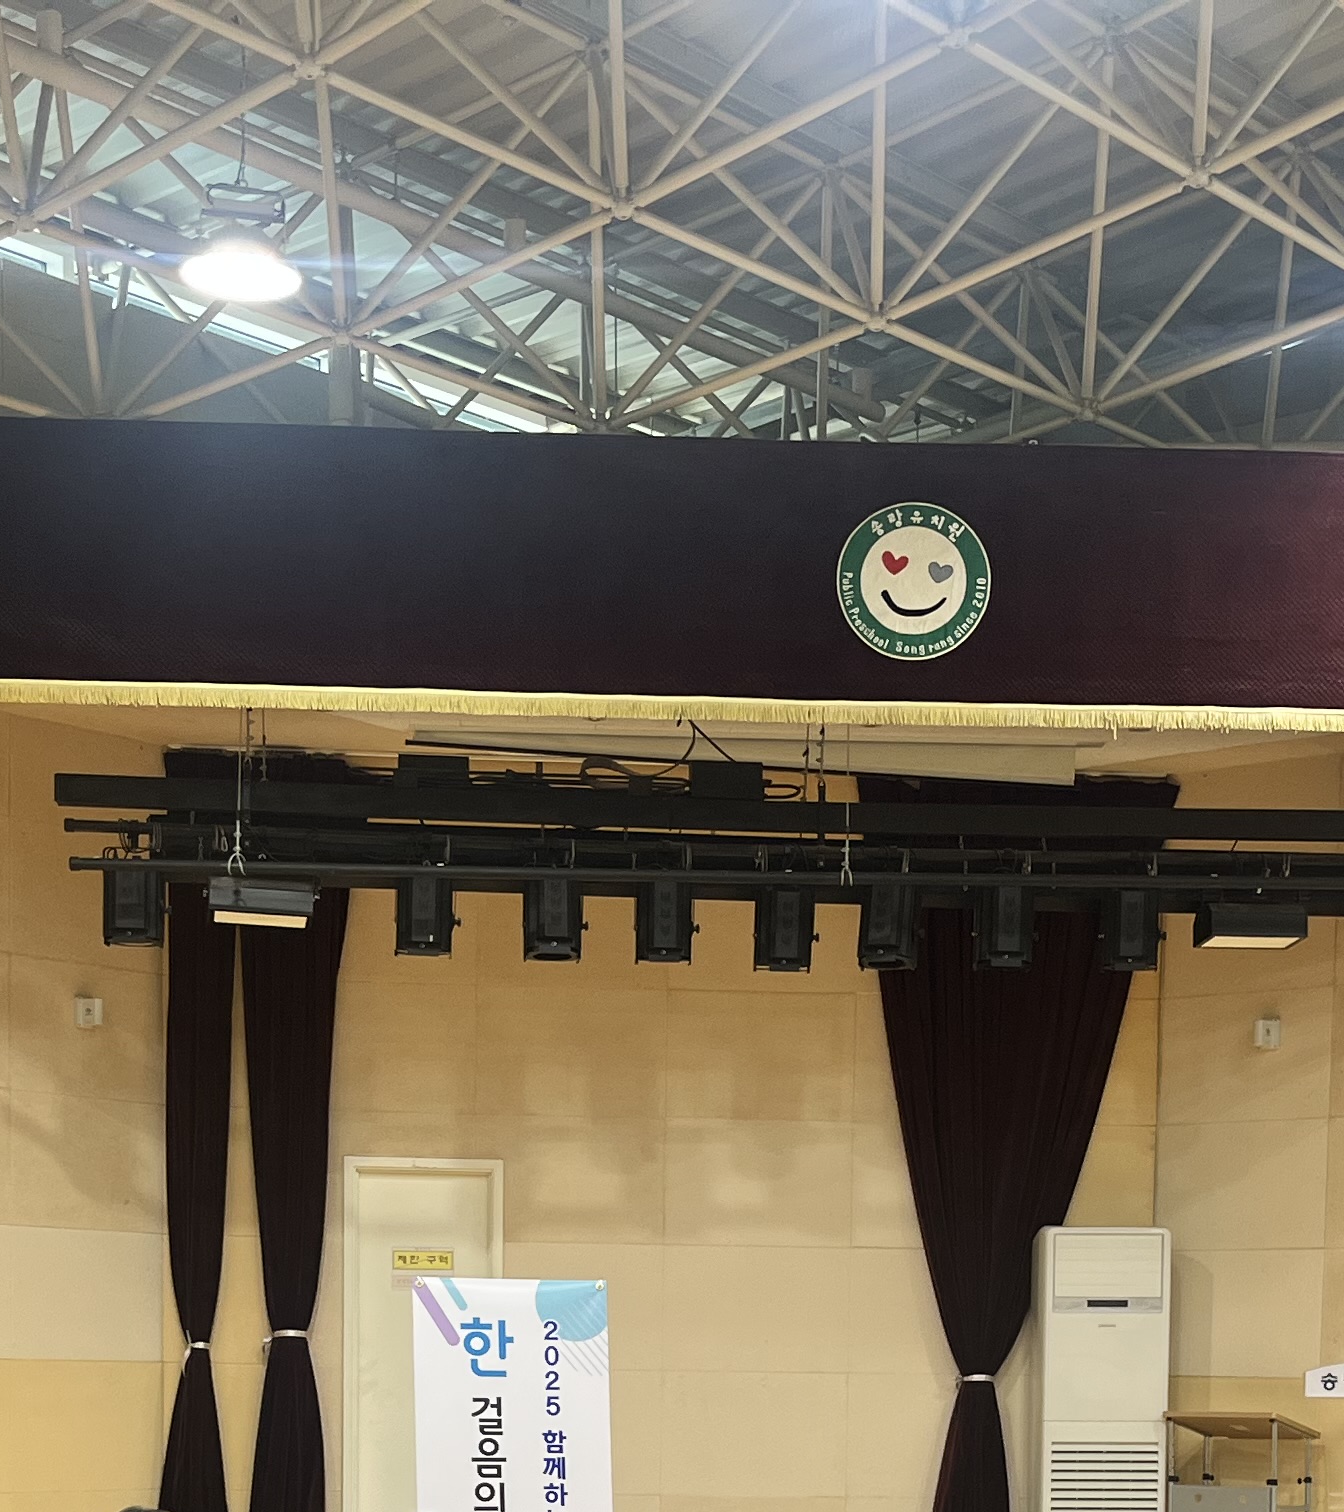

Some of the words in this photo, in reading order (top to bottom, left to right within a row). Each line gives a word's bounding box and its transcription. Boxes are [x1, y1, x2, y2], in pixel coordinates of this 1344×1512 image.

[871, 509, 965, 542] 송랑유치원
[842, 571, 854, 607] Public
[849, 607, 889, 650] Preschool
[972, 577, 987, 608] 2010
[460, 1317, 514, 1377] 한
[543, 1321, 561, 1416] 2025
[471, 1397, 507, 1512] 걸음의
